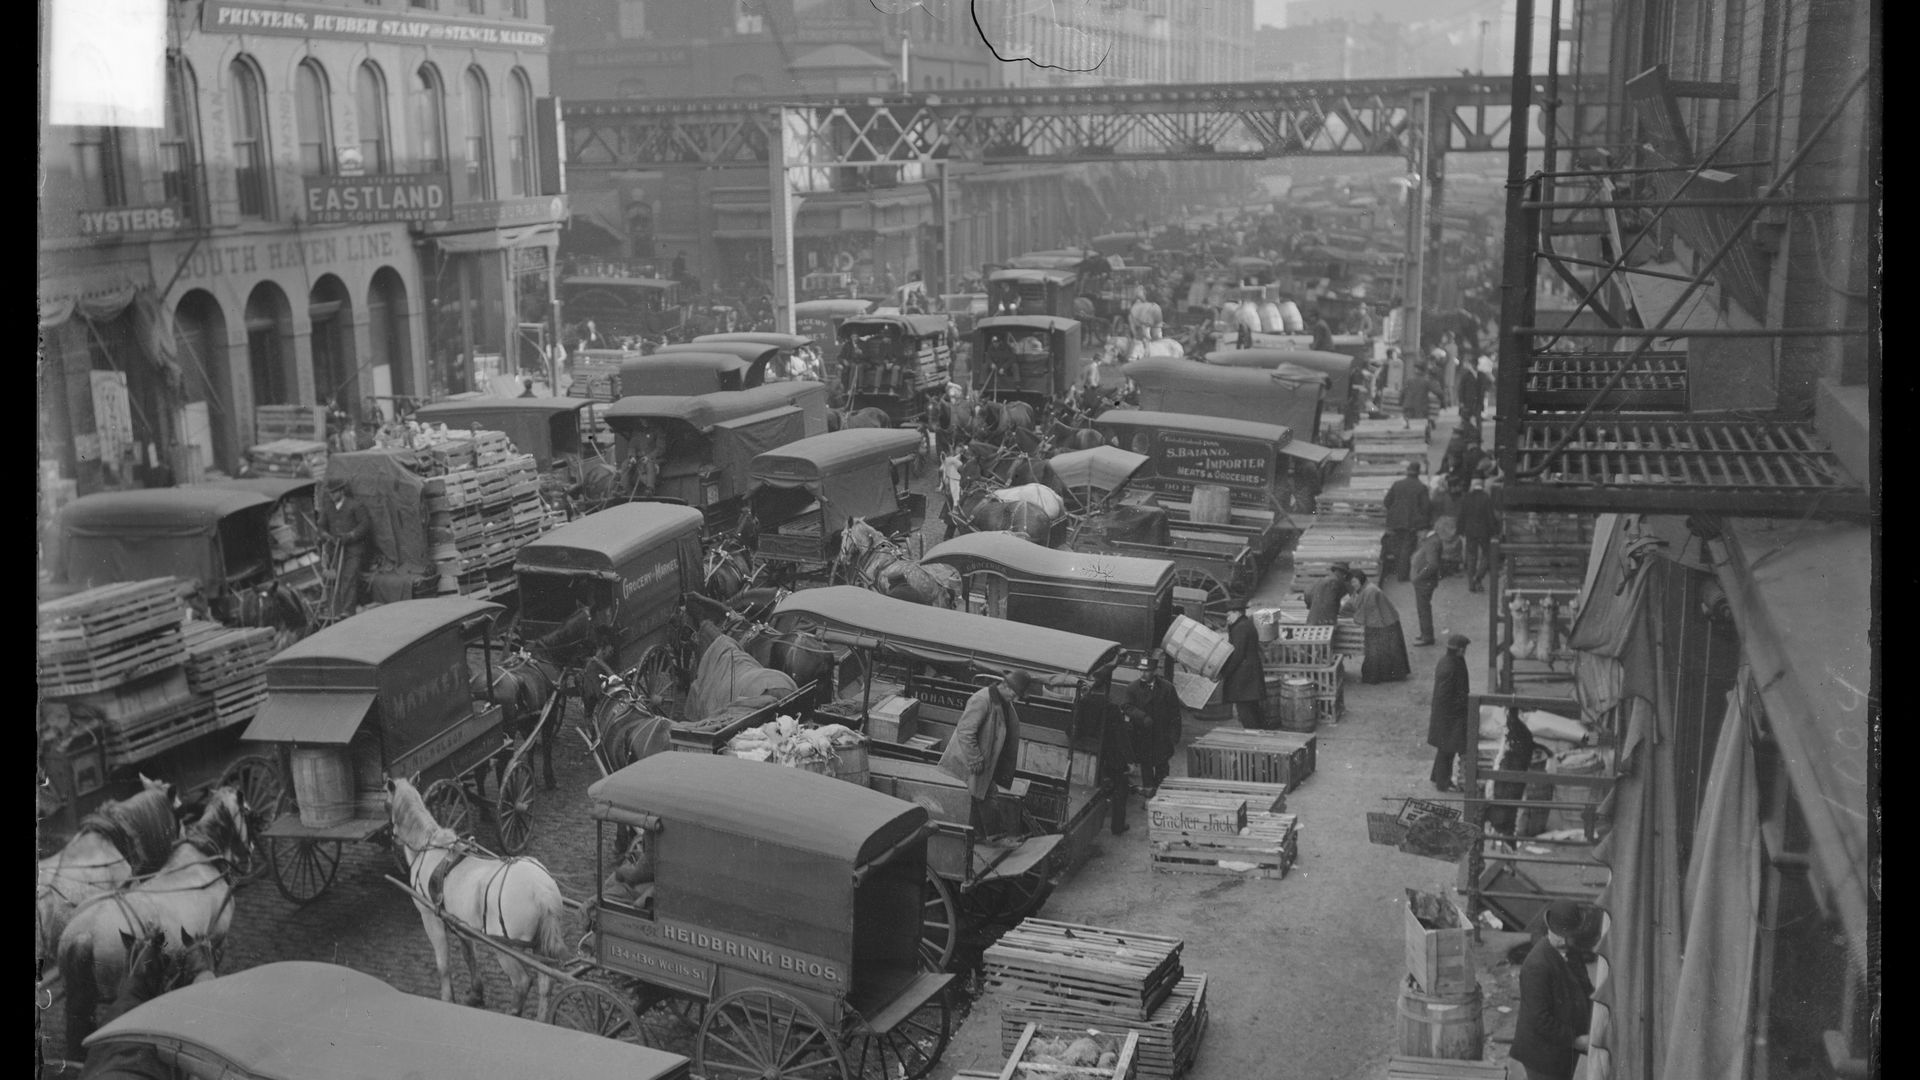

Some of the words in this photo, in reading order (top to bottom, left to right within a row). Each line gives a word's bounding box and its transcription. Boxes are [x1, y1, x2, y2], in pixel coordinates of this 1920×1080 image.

[217, 7, 308, 30] PRINTERS,
[313, 14, 378, 34] RUBBER
[381, 20, 430, 38] STAMP
[445, 25, 498, 43] STENCIL
[309, 185, 444, 211] EASTLAND
[317, 211, 341, 221] FOR
[348, 211, 389, 221] SOUTH
[395, 209, 437, 220] HAVEN
[176, 245, 257, 281] SOUTH
[269, 237, 343, 270] HAVEN
[1177, 466, 1206, 478] MEATS
[1214, 470, 1260, 484] GROCERIES
[1205, 457, 1265, 470] IMPORTER
[1152, 810, 1200, 830] Cracker
[1203, 813, 1235, 834] Jack
[664, 923, 774, 966] HEIDBRINK
[779, 953, 844, 982] BROS.
[658, 957, 691, 977] Wells
